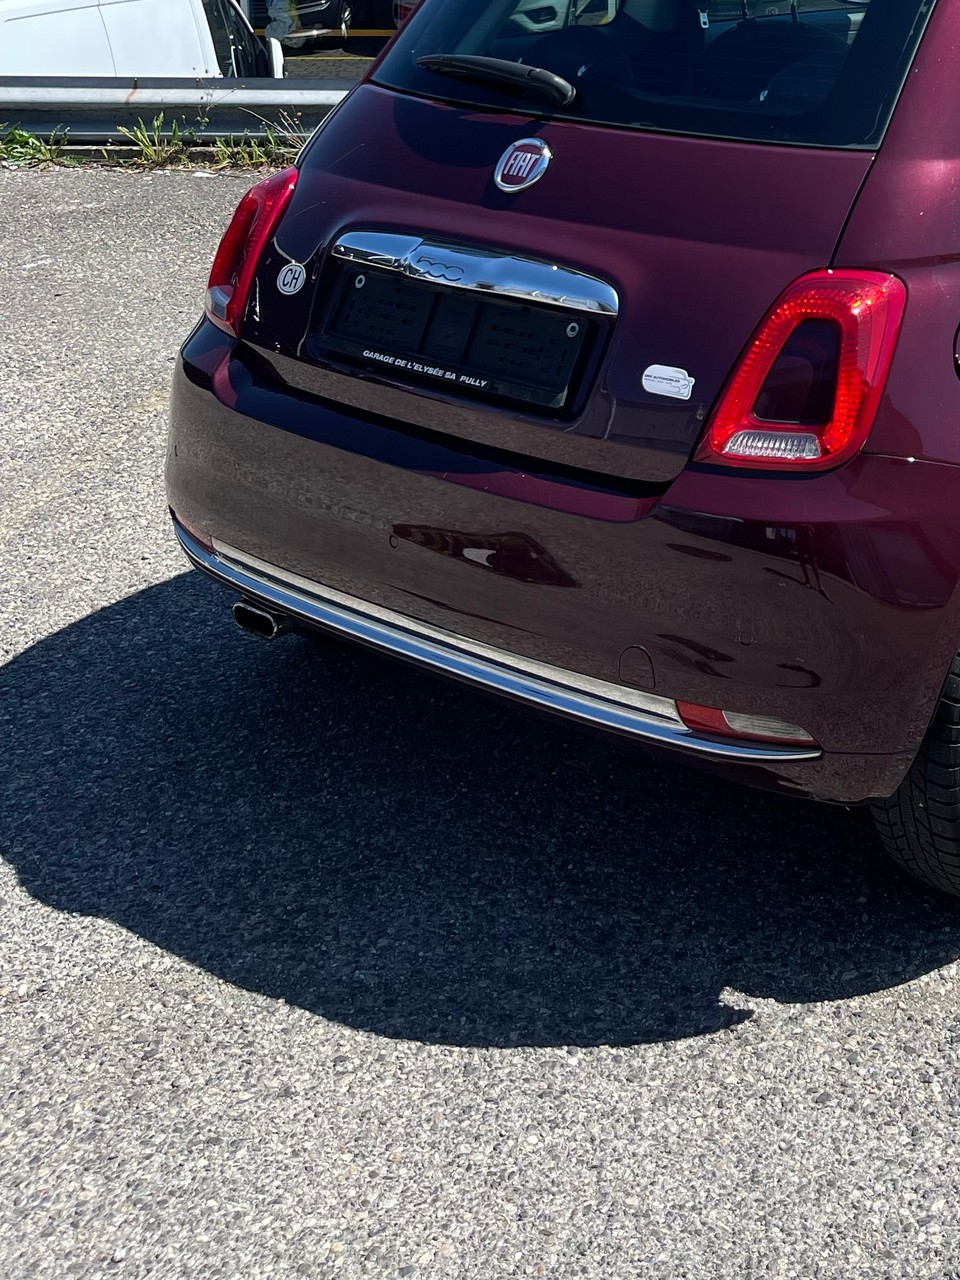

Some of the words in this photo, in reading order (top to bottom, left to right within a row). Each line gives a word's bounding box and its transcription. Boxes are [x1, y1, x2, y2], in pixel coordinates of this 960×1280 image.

[503, 151, 540, 177] FIAT
[282, 268, 302, 289] CH
[362, 350, 395, 365] GARAGE
[395, 358, 406, 367] DE
[407, 362, 444, 377] L'ELYSÉE
[444, 371, 456, 380] SA
[459, 375, 488, 387] PULLY
